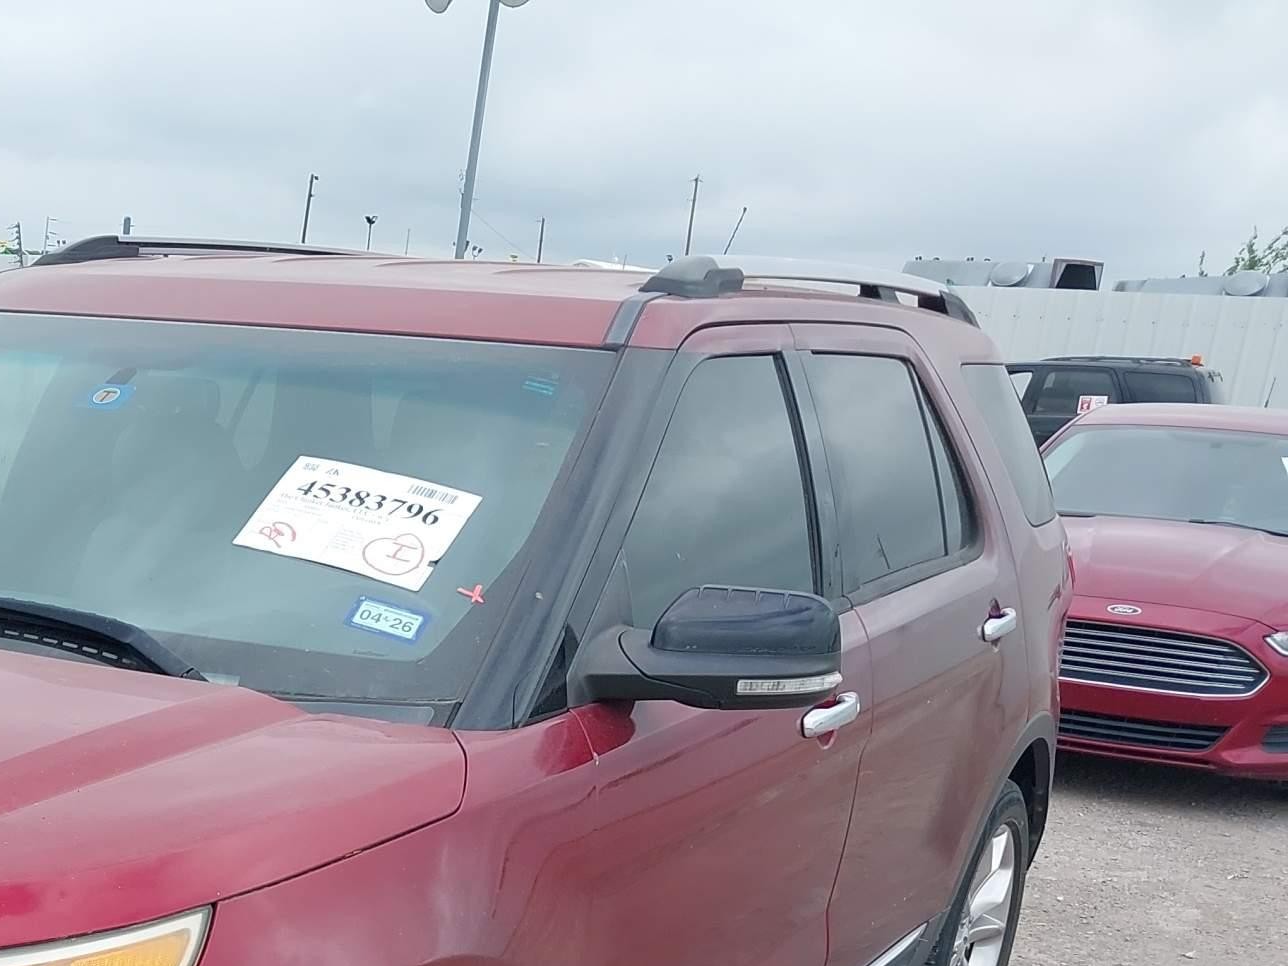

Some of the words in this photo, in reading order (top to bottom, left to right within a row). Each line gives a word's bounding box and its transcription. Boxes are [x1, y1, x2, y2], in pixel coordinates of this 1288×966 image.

[296, 480, 446, 527] 45383796
[359, 609, 383, 623] 04
[389, 617, 415, 633] 26
